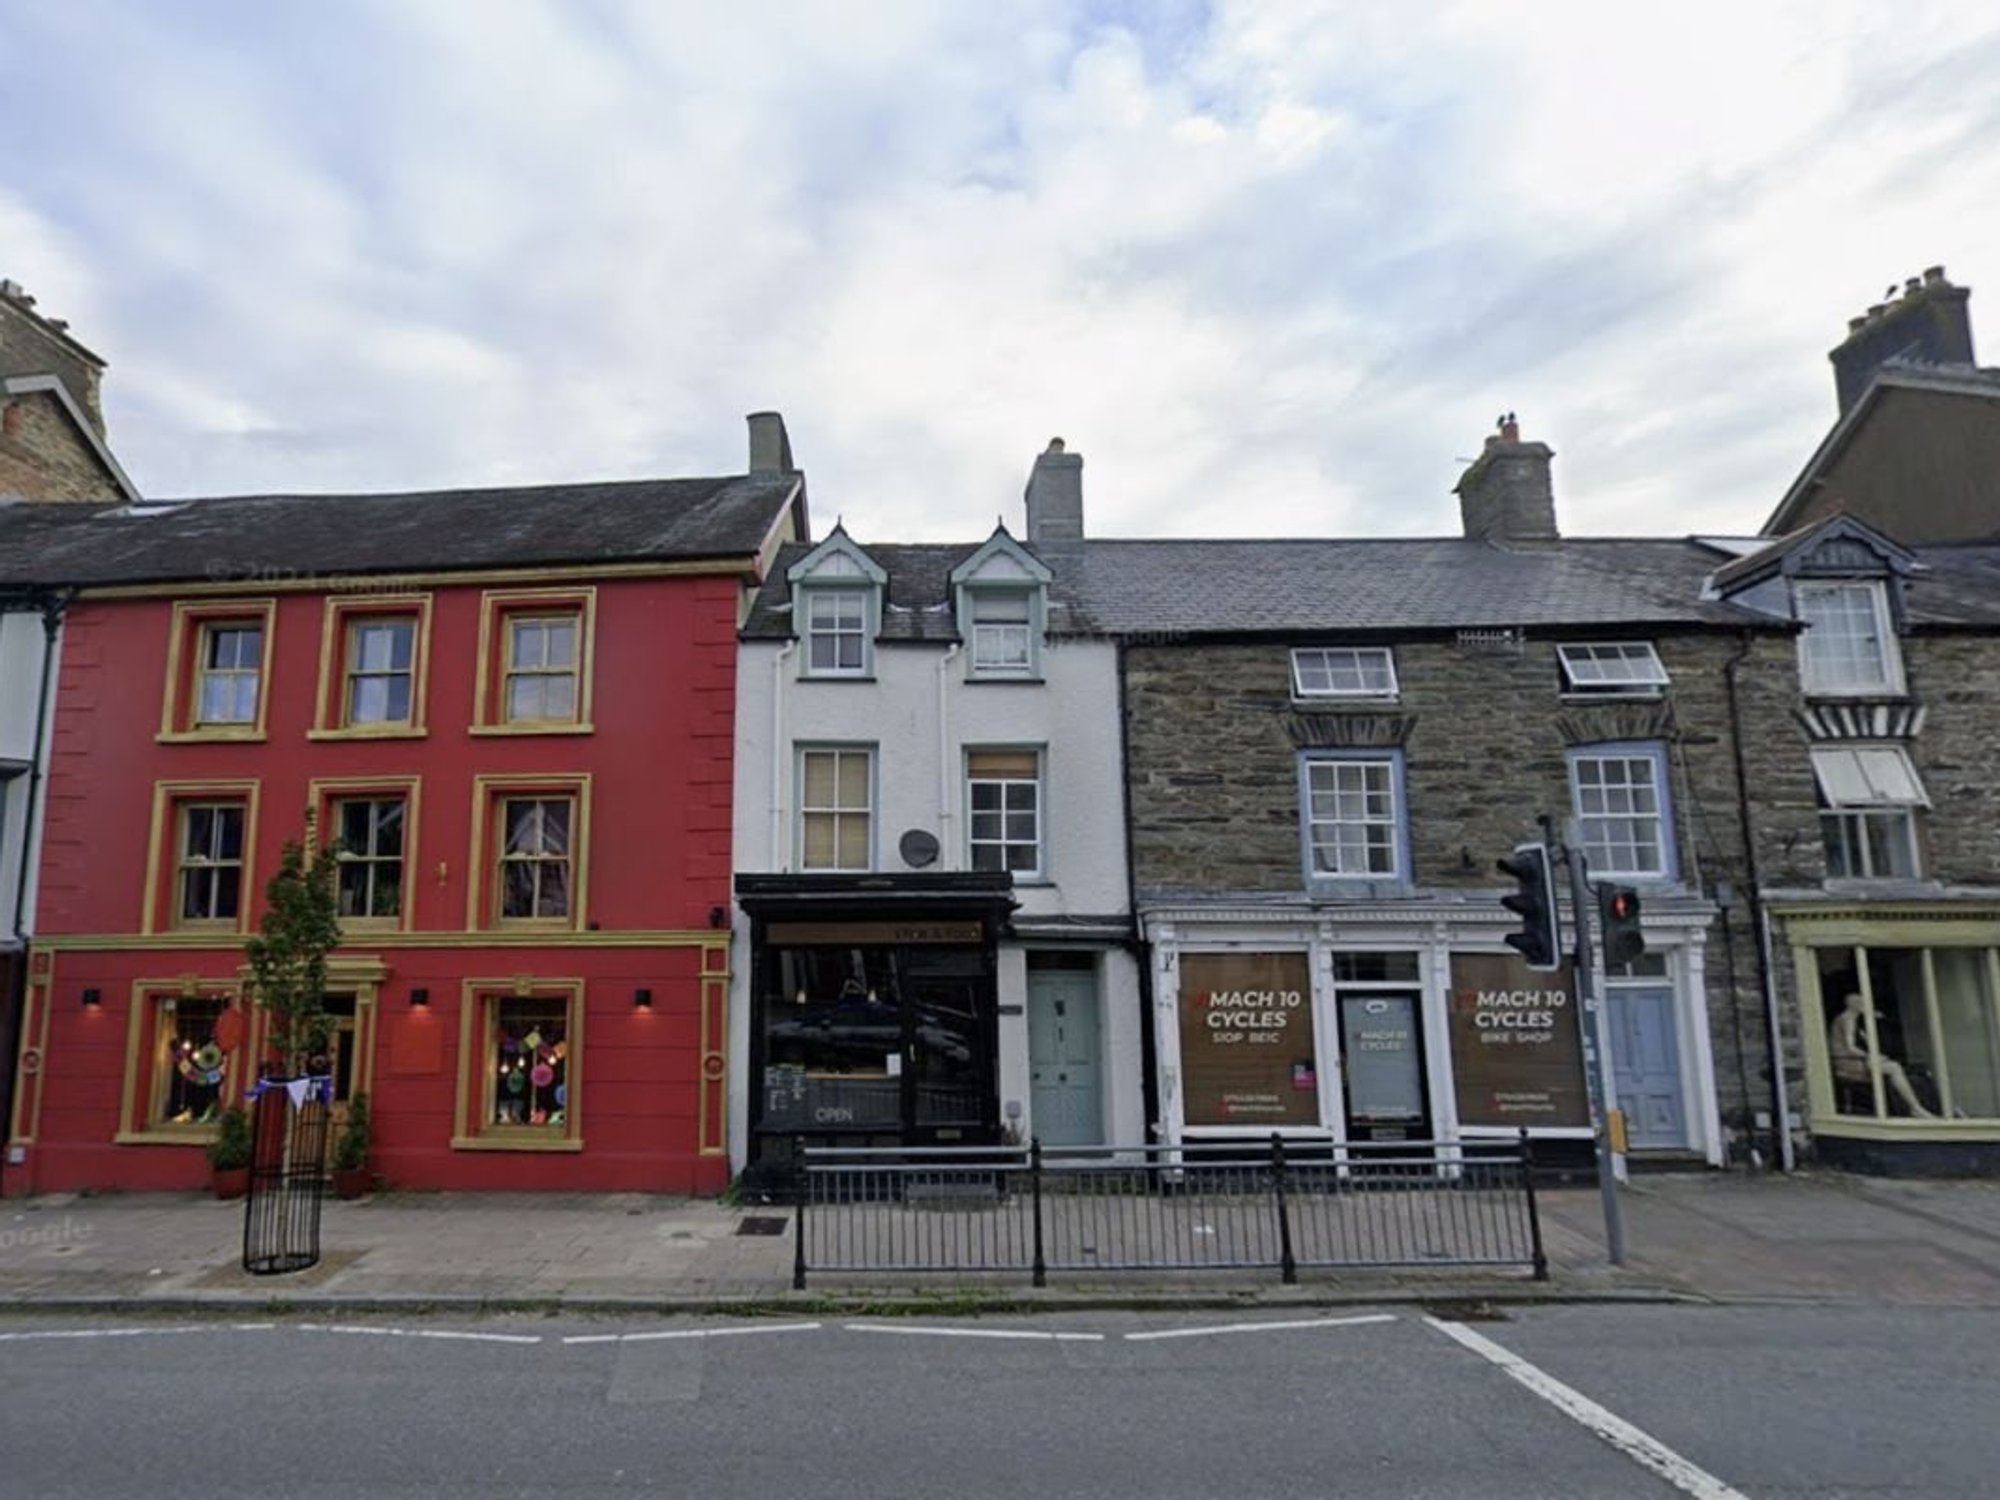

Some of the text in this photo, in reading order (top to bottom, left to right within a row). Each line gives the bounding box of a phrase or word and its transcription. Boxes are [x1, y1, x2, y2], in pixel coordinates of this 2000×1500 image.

[1210, 991, 1301, 1008] MACH 10
[1476, 990, 1567, 1007] MACH 10
[1206, 1011, 1287, 1028] CYCLES
[1474, 1010, 1555, 1027] CYCLES
[815, 1107, 853, 1123] OPEN
